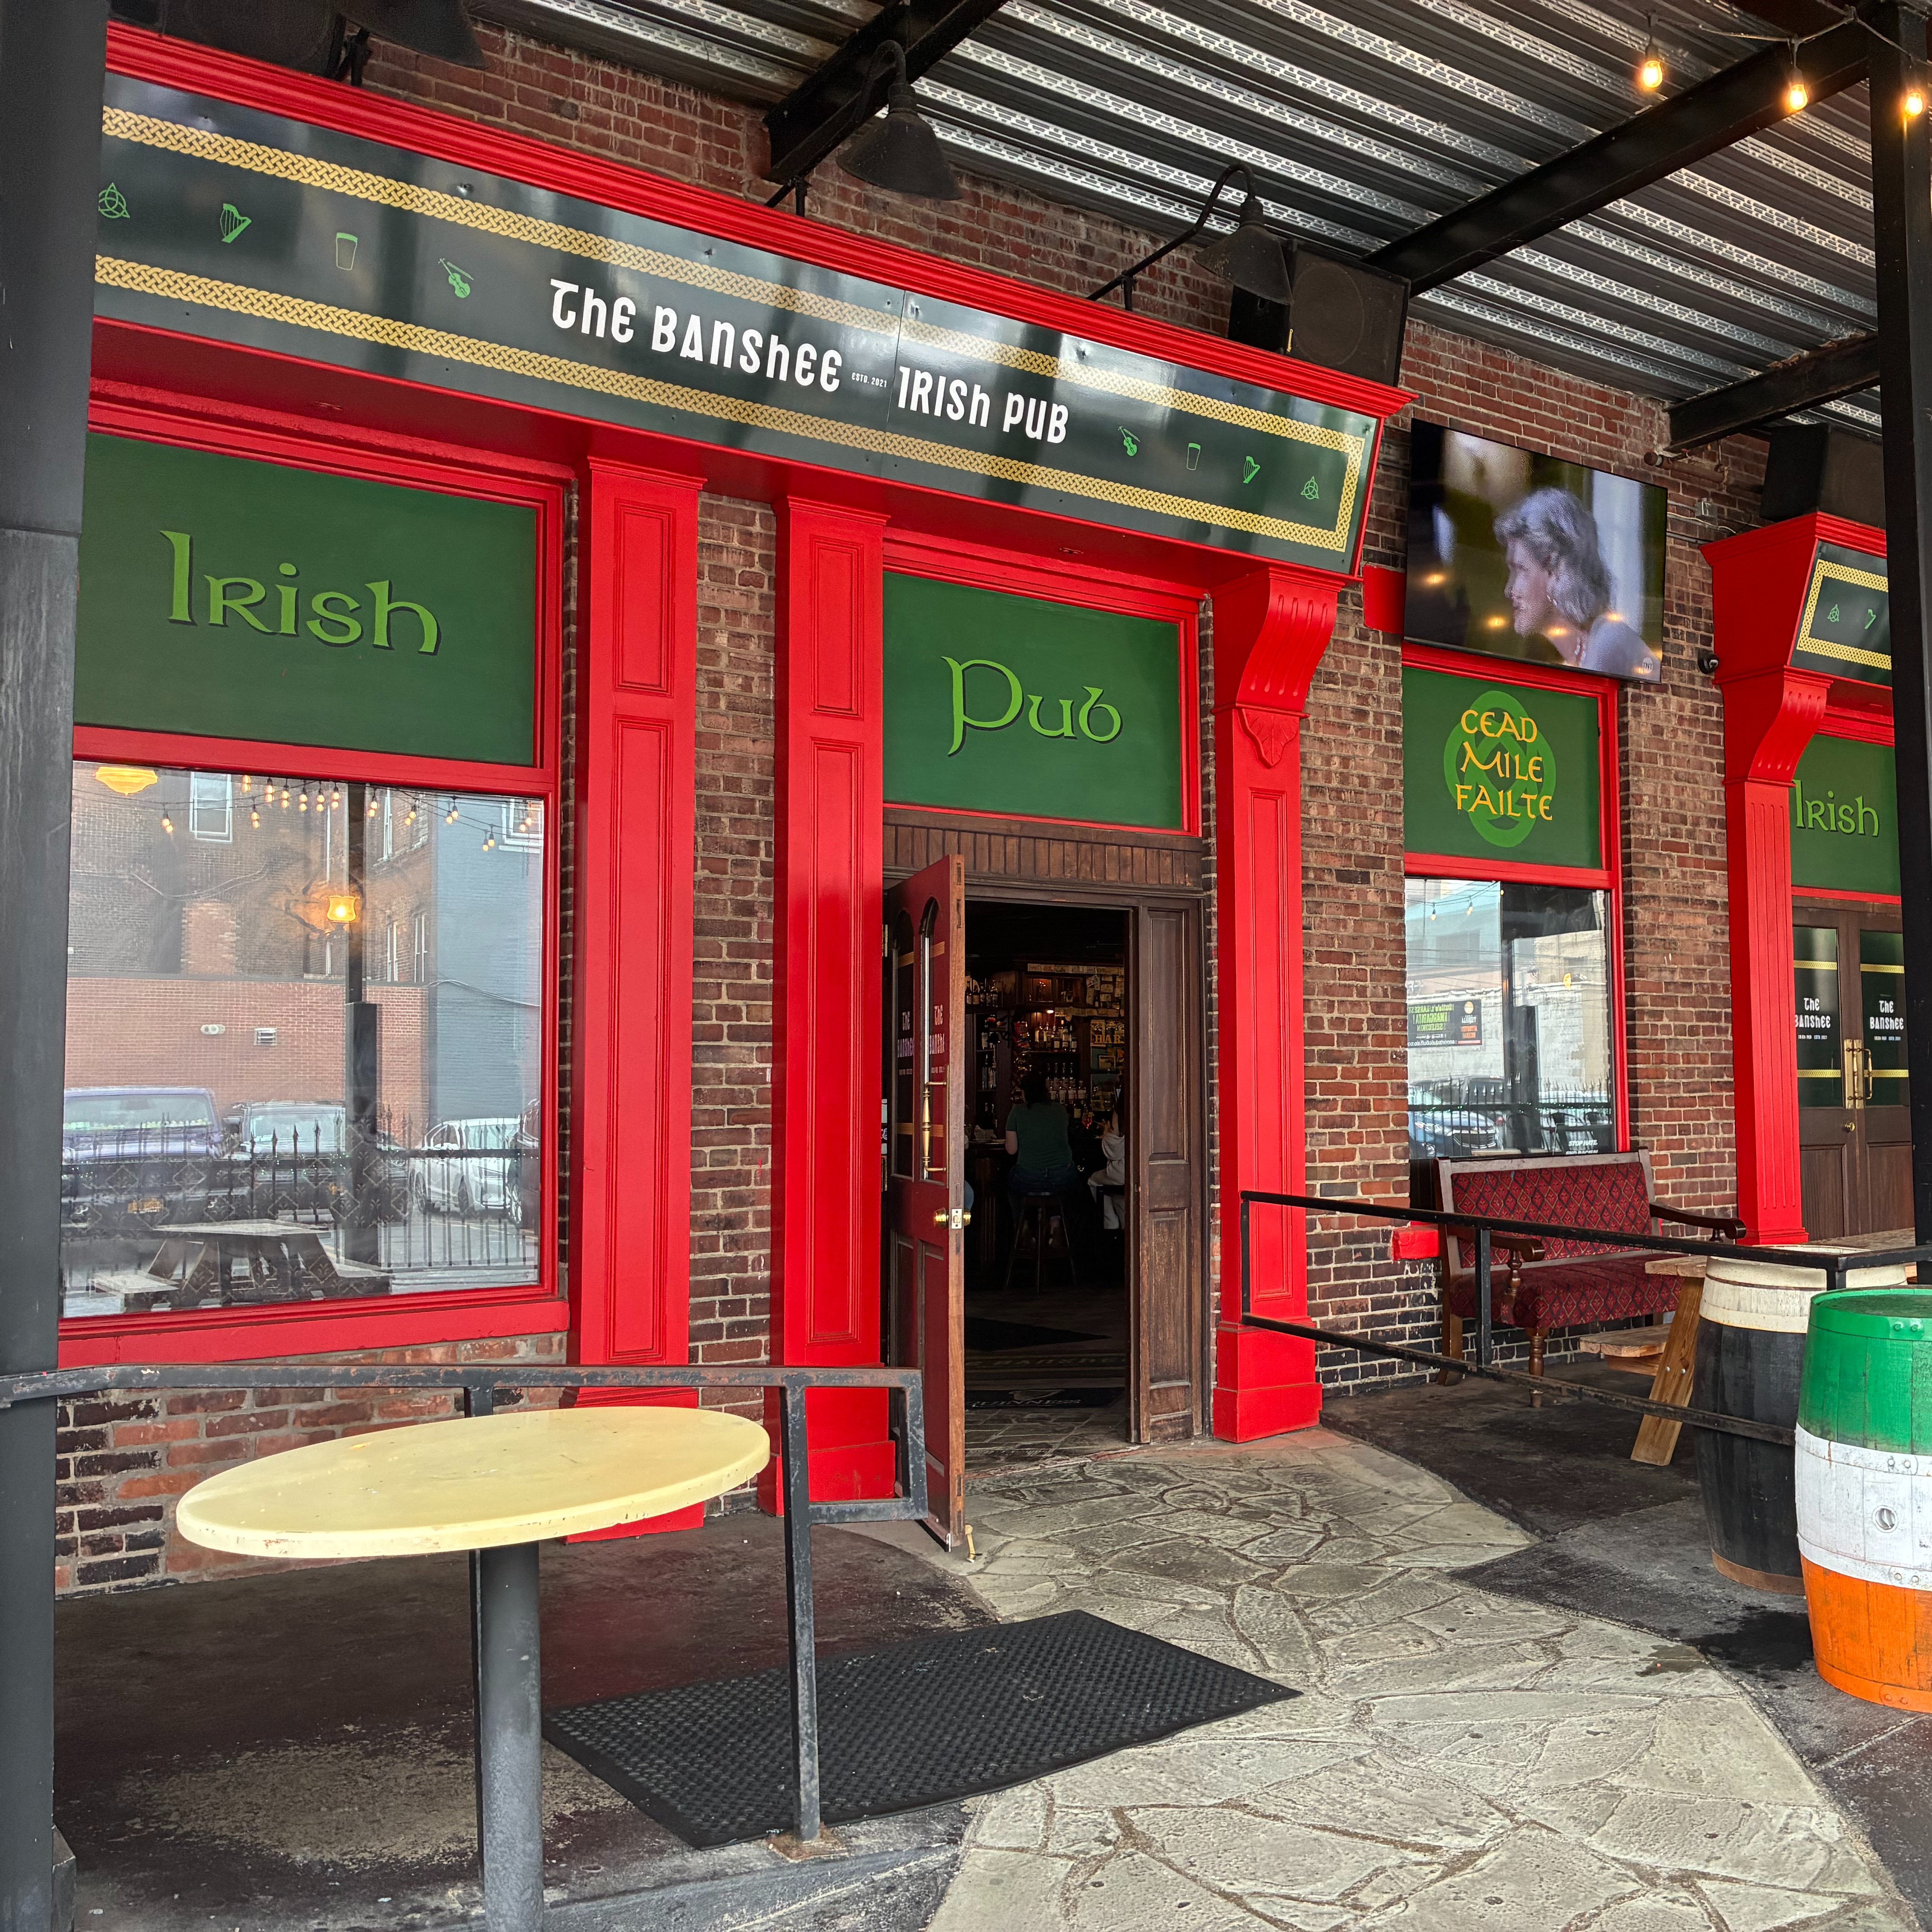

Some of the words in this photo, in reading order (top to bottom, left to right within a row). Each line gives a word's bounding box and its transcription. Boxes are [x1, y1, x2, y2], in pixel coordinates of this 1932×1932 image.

[851, 372, 869, 384] ESTD.
[871, 377, 887, 388] 2021
[159, 530, 441, 656] Irish
[941, 657, 1123, 756] Pub
[1461, 709, 1537, 743] CEAD
[1461, 741, 1543, 782] MILE
[1456, 784, 1553, 820] FAILTE
[1792, 779, 1879, 837] Irish
